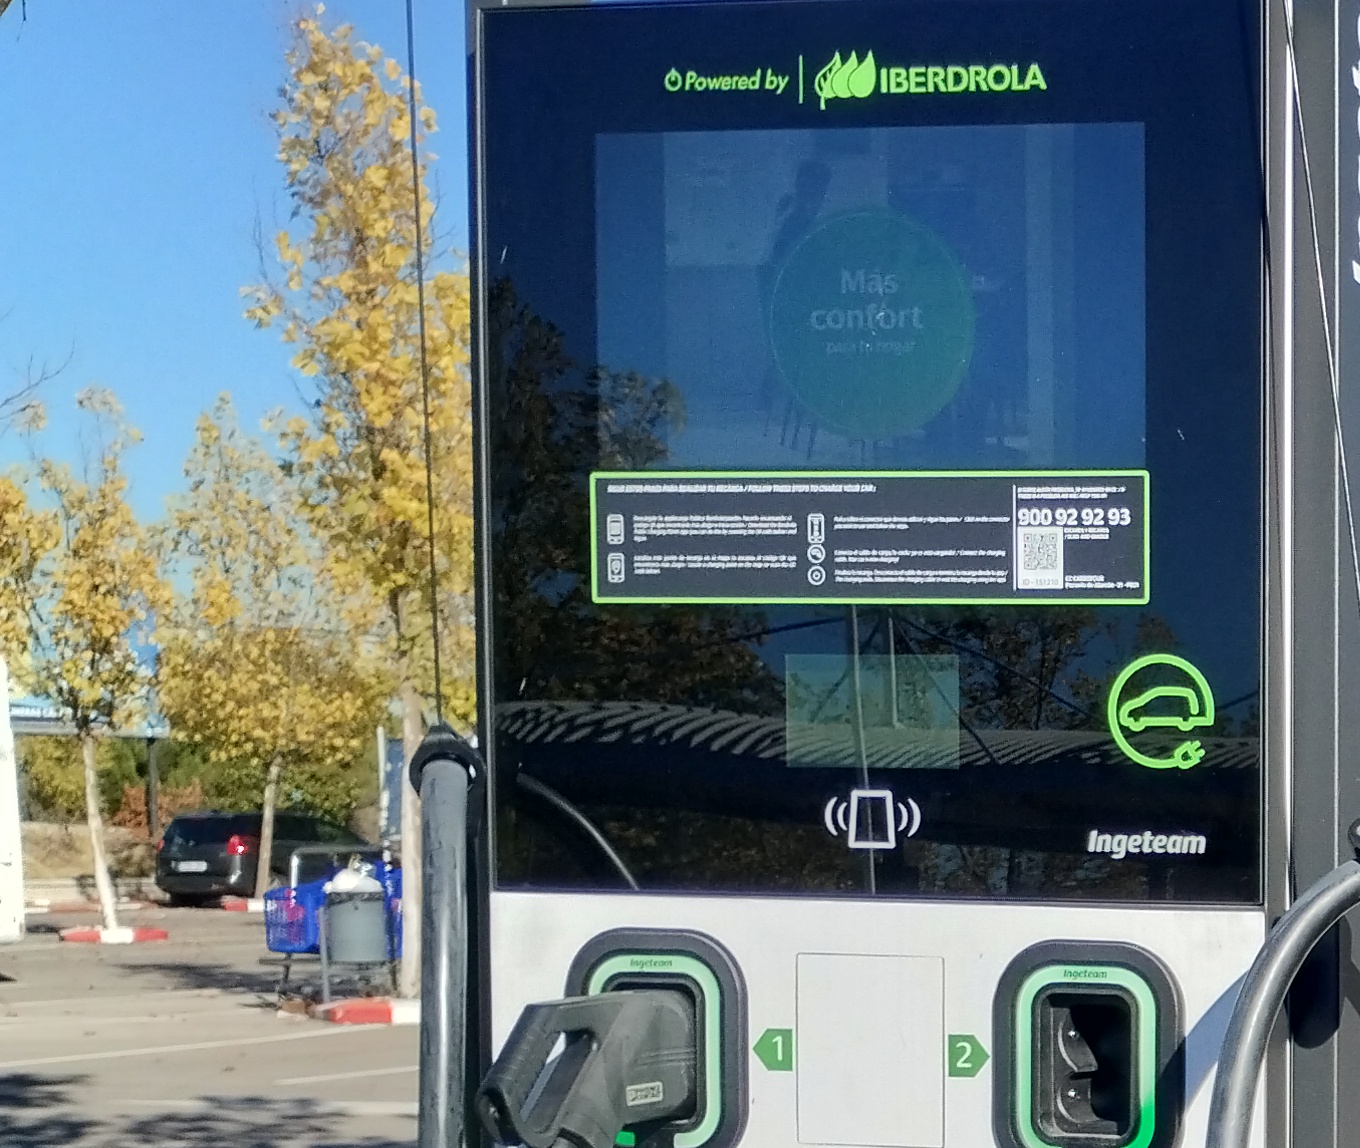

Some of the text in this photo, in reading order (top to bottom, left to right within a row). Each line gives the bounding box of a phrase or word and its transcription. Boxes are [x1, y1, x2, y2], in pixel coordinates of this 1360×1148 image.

[685, 62, 1047, 94] Powered by IBERDROLA
[841, 269, 898, 296] Más
[810, 303, 924, 330] confort
[1017, 507, 1053, 526] 900
[1055, 507, 1078, 526] 92
[1081, 507, 1105, 526] 92
[1107, 507, 1131, 526] 93
[1087, 829, 1207, 860] Ingeteam
[629, 959, 673, 969] Ingeteam
[1063, 969, 1108, 980] Ingeteam
[772, 1035, 783, 1061] 1
[955, 1041, 972, 1068] 2
